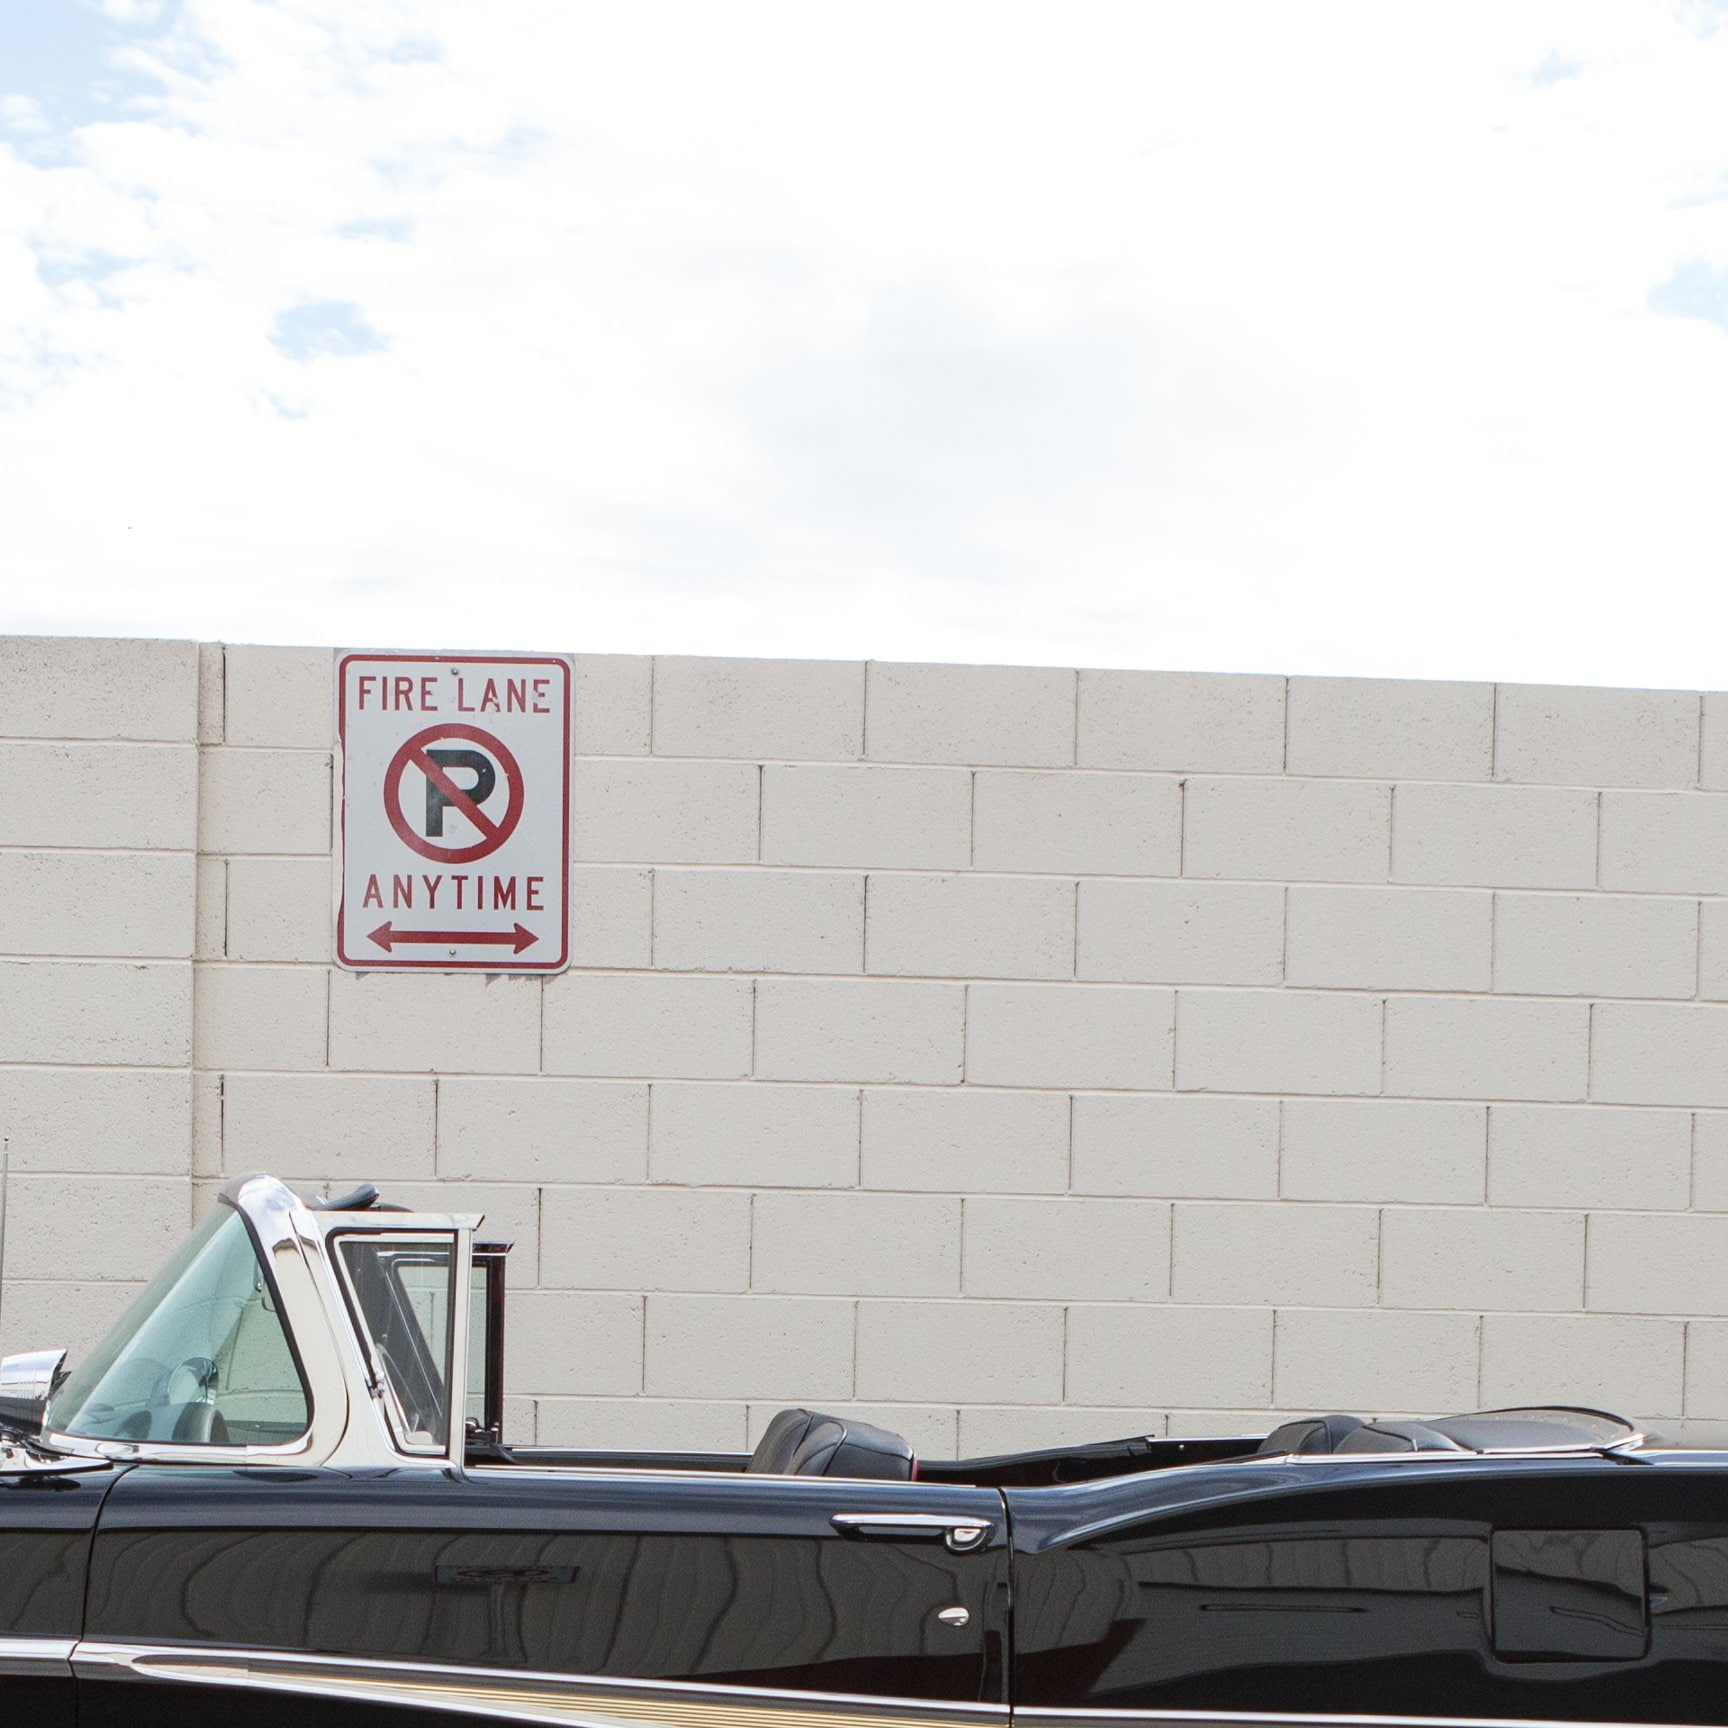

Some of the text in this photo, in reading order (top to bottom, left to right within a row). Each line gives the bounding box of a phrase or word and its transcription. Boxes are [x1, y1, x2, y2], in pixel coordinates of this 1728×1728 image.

[358, 676, 551, 713] FIRE LANE
[425, 748, 496, 837] P
[362, 874, 544, 911] ANYTIME
